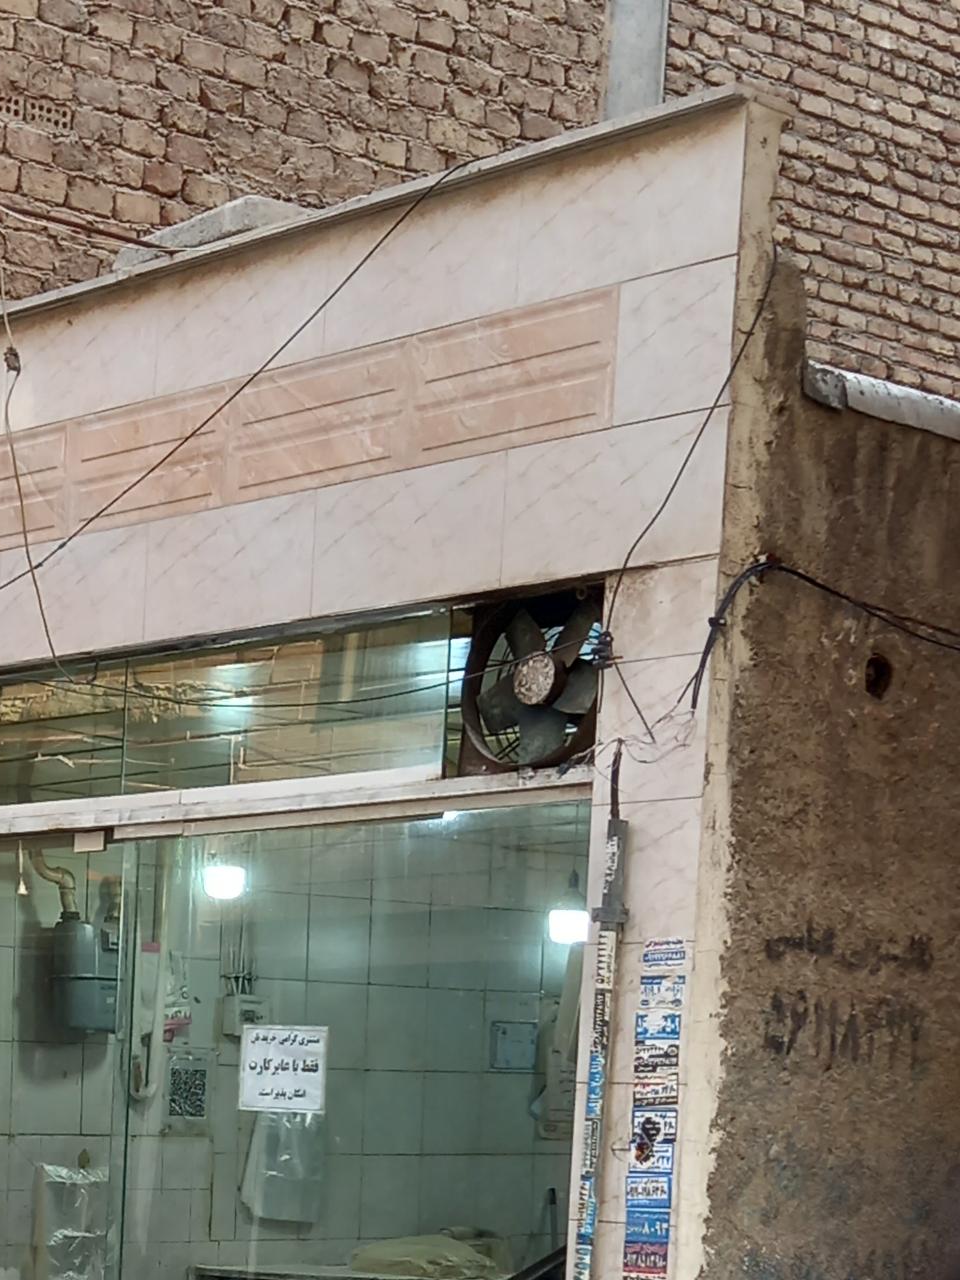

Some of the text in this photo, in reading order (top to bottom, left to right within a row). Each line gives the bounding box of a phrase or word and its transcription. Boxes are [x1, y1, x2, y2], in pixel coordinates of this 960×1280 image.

[278, 1031, 298, 1046] گرامی
[292, 1059, 300, 1075] با
[301, 1058, 319, 1073] فقط
